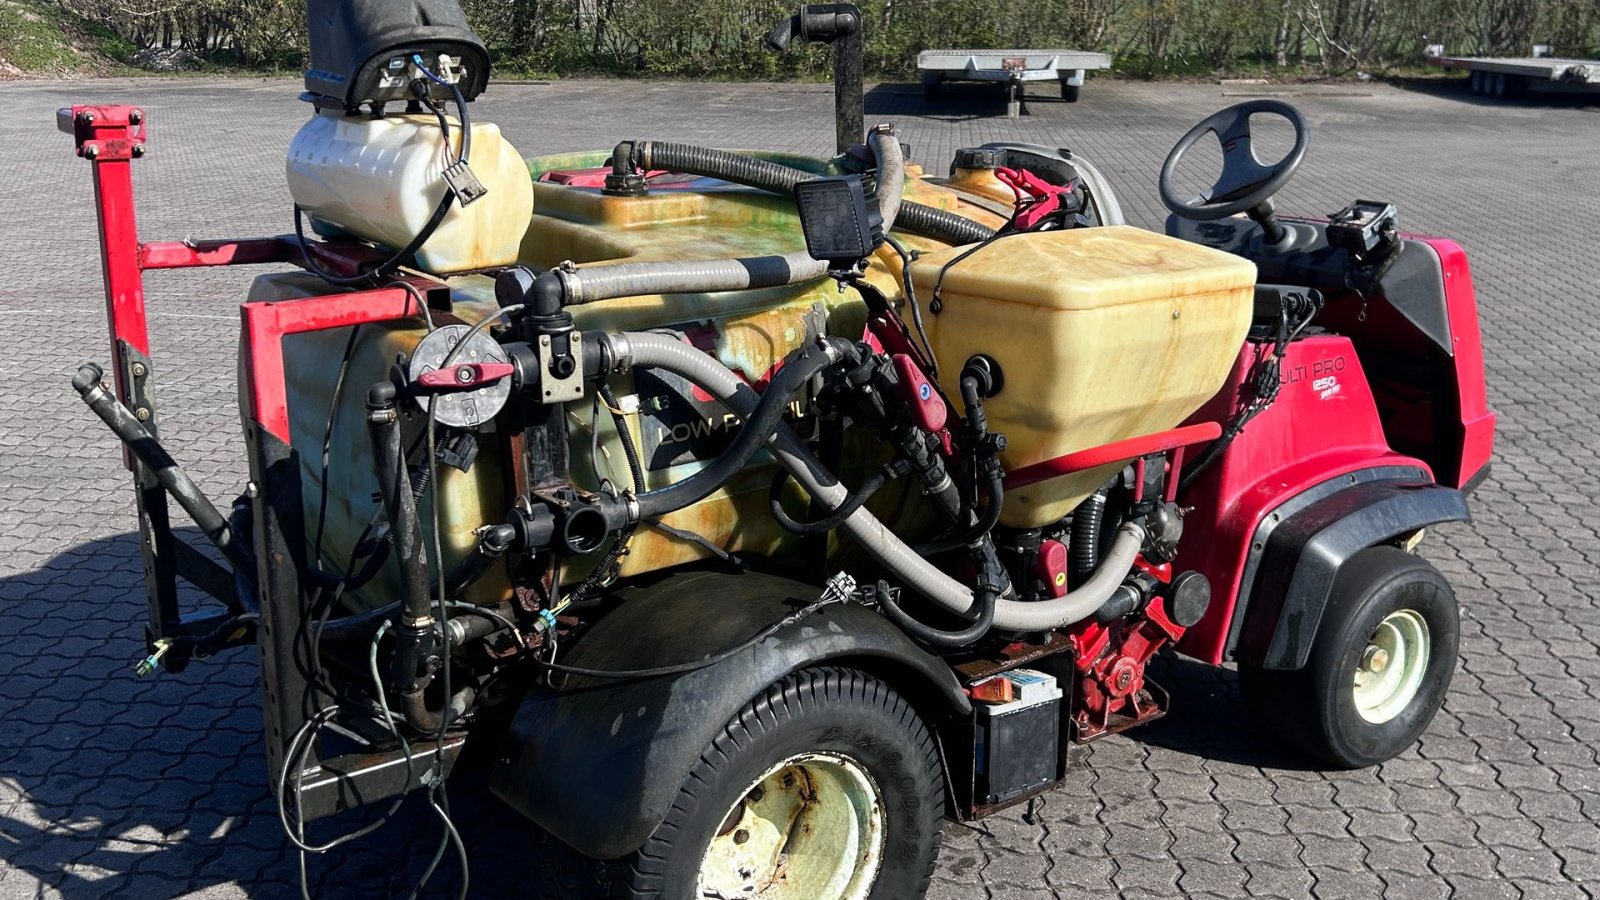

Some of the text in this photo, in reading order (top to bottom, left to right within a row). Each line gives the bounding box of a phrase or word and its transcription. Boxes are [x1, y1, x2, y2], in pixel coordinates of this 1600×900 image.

[1279, 357, 1345, 384] ULTI PRO
[657, 416, 713, 446] LOW
